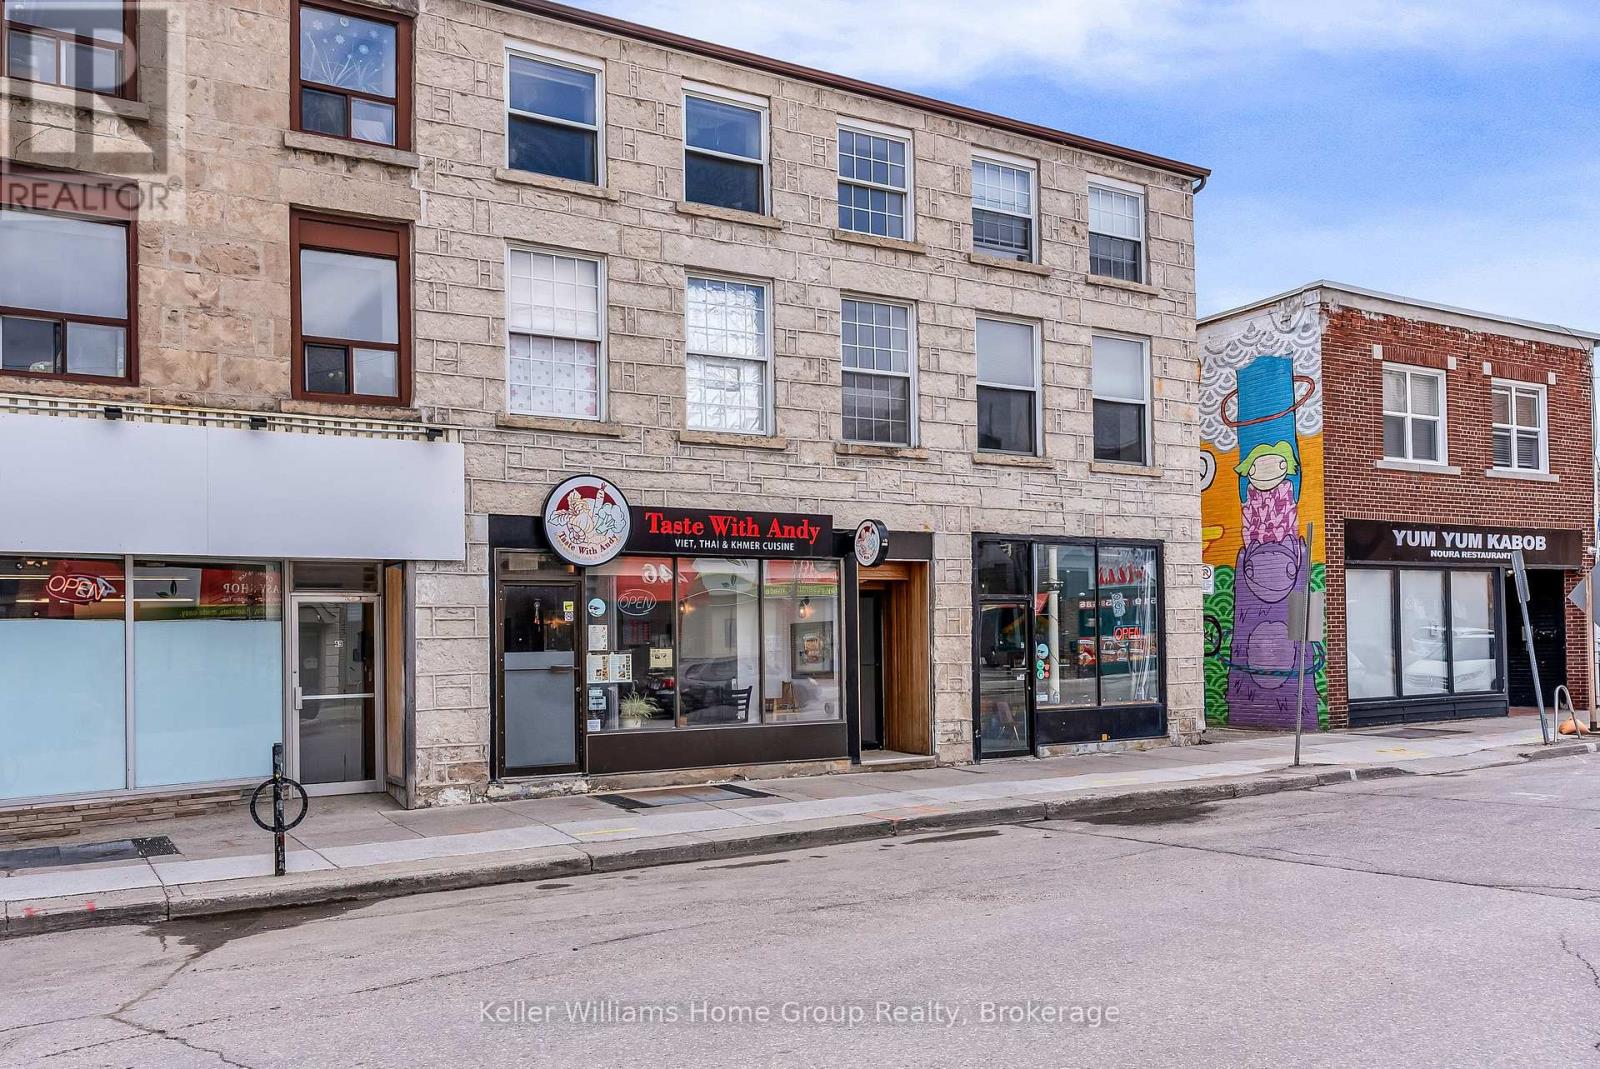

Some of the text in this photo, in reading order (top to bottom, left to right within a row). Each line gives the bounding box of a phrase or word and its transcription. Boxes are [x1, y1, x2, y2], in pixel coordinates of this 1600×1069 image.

[645, 512, 821, 545] Taste With Andy
[558, 530, 619, 556] Taste With Andy
[674, 538, 795, 551] VIET, THAI & KHMER CUISINE
[1392, 529, 1547, 551] YUM YUM KABOB
[1430, 550, 1512, 560] NOURA RESTAURANT
[49, 575, 105, 600] OPEN
[620, 595, 653, 609] OPEN
[1114, 626, 1141, 641] OPEN
